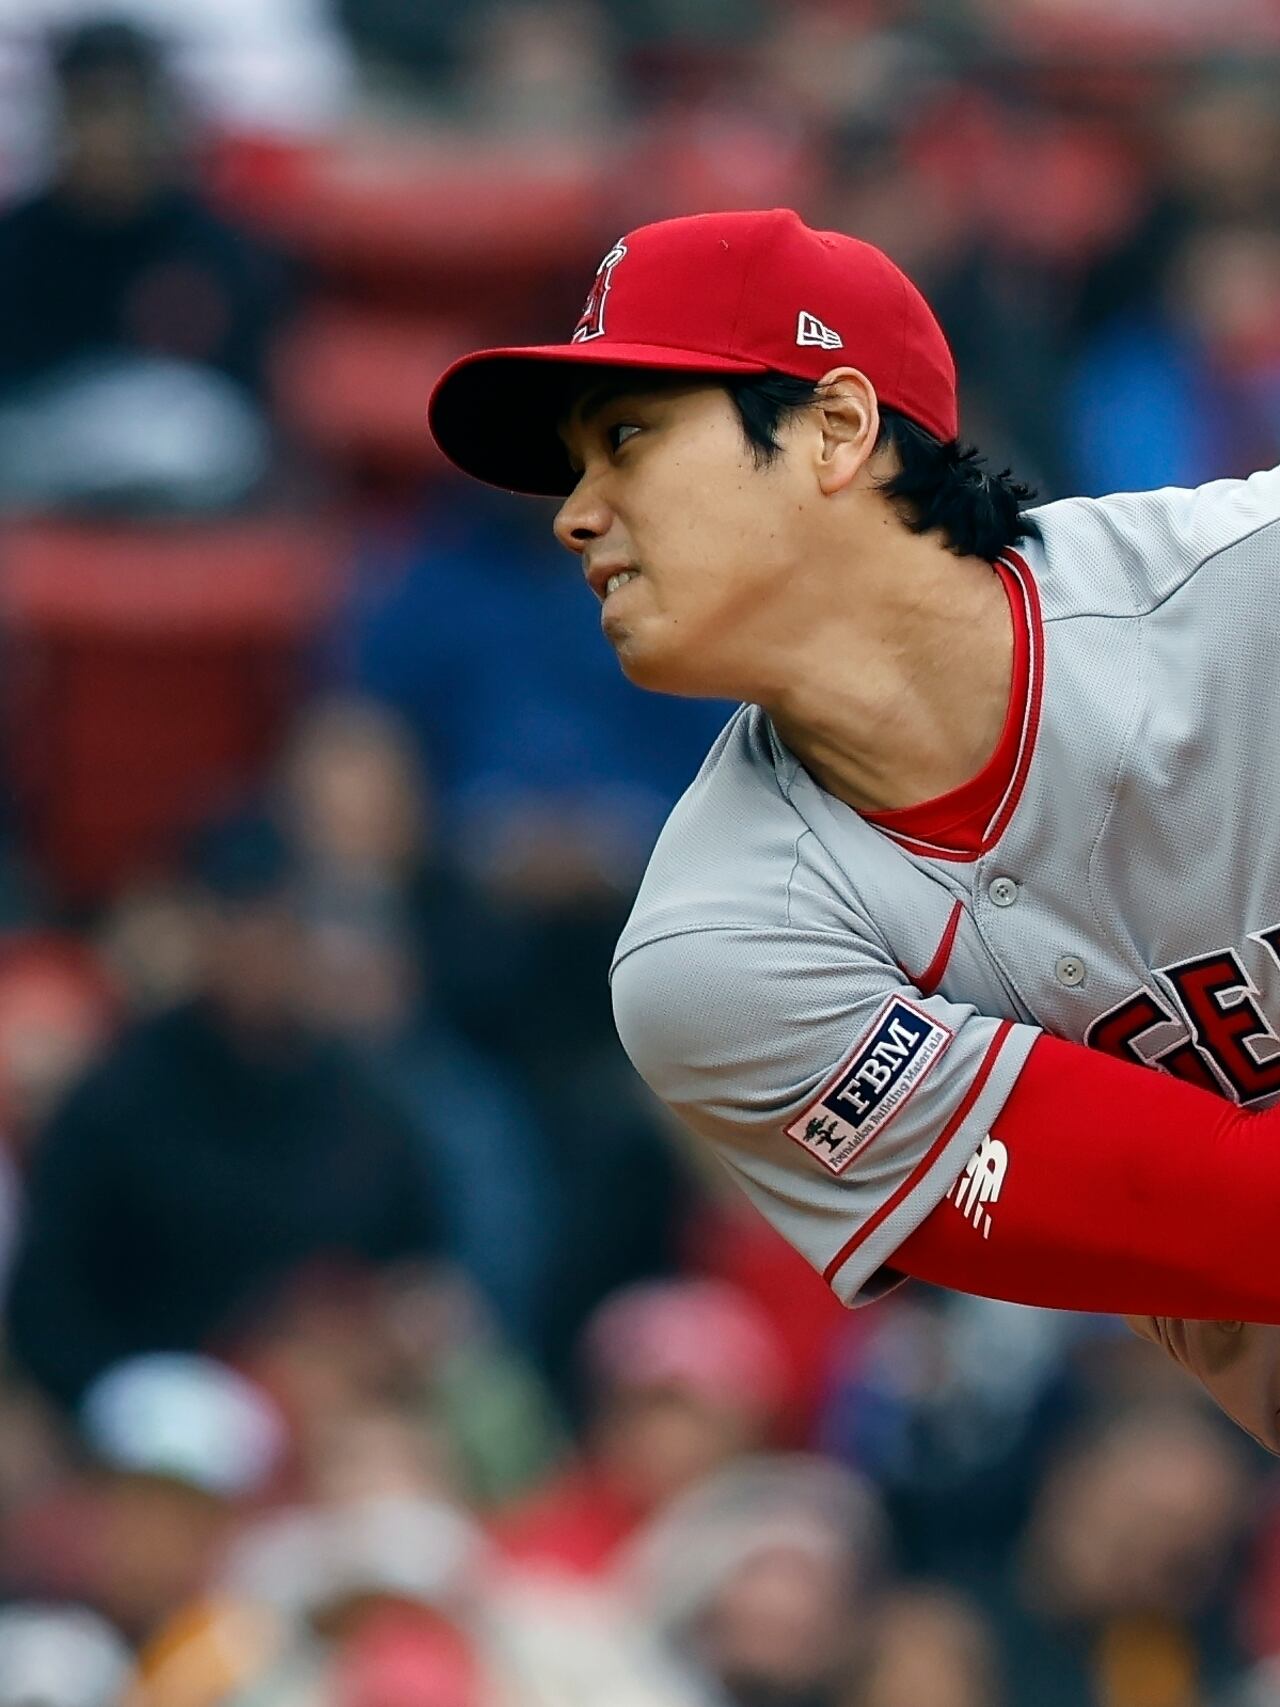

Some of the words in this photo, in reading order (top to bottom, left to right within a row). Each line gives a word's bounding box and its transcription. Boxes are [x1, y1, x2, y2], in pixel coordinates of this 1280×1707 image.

[829, 1125, 875, 1168] Foundation
[871, 1079, 910, 1126] Building
[903, 1031, 943, 1084] Materials
[837, 1017, 920, 1115] FBM
